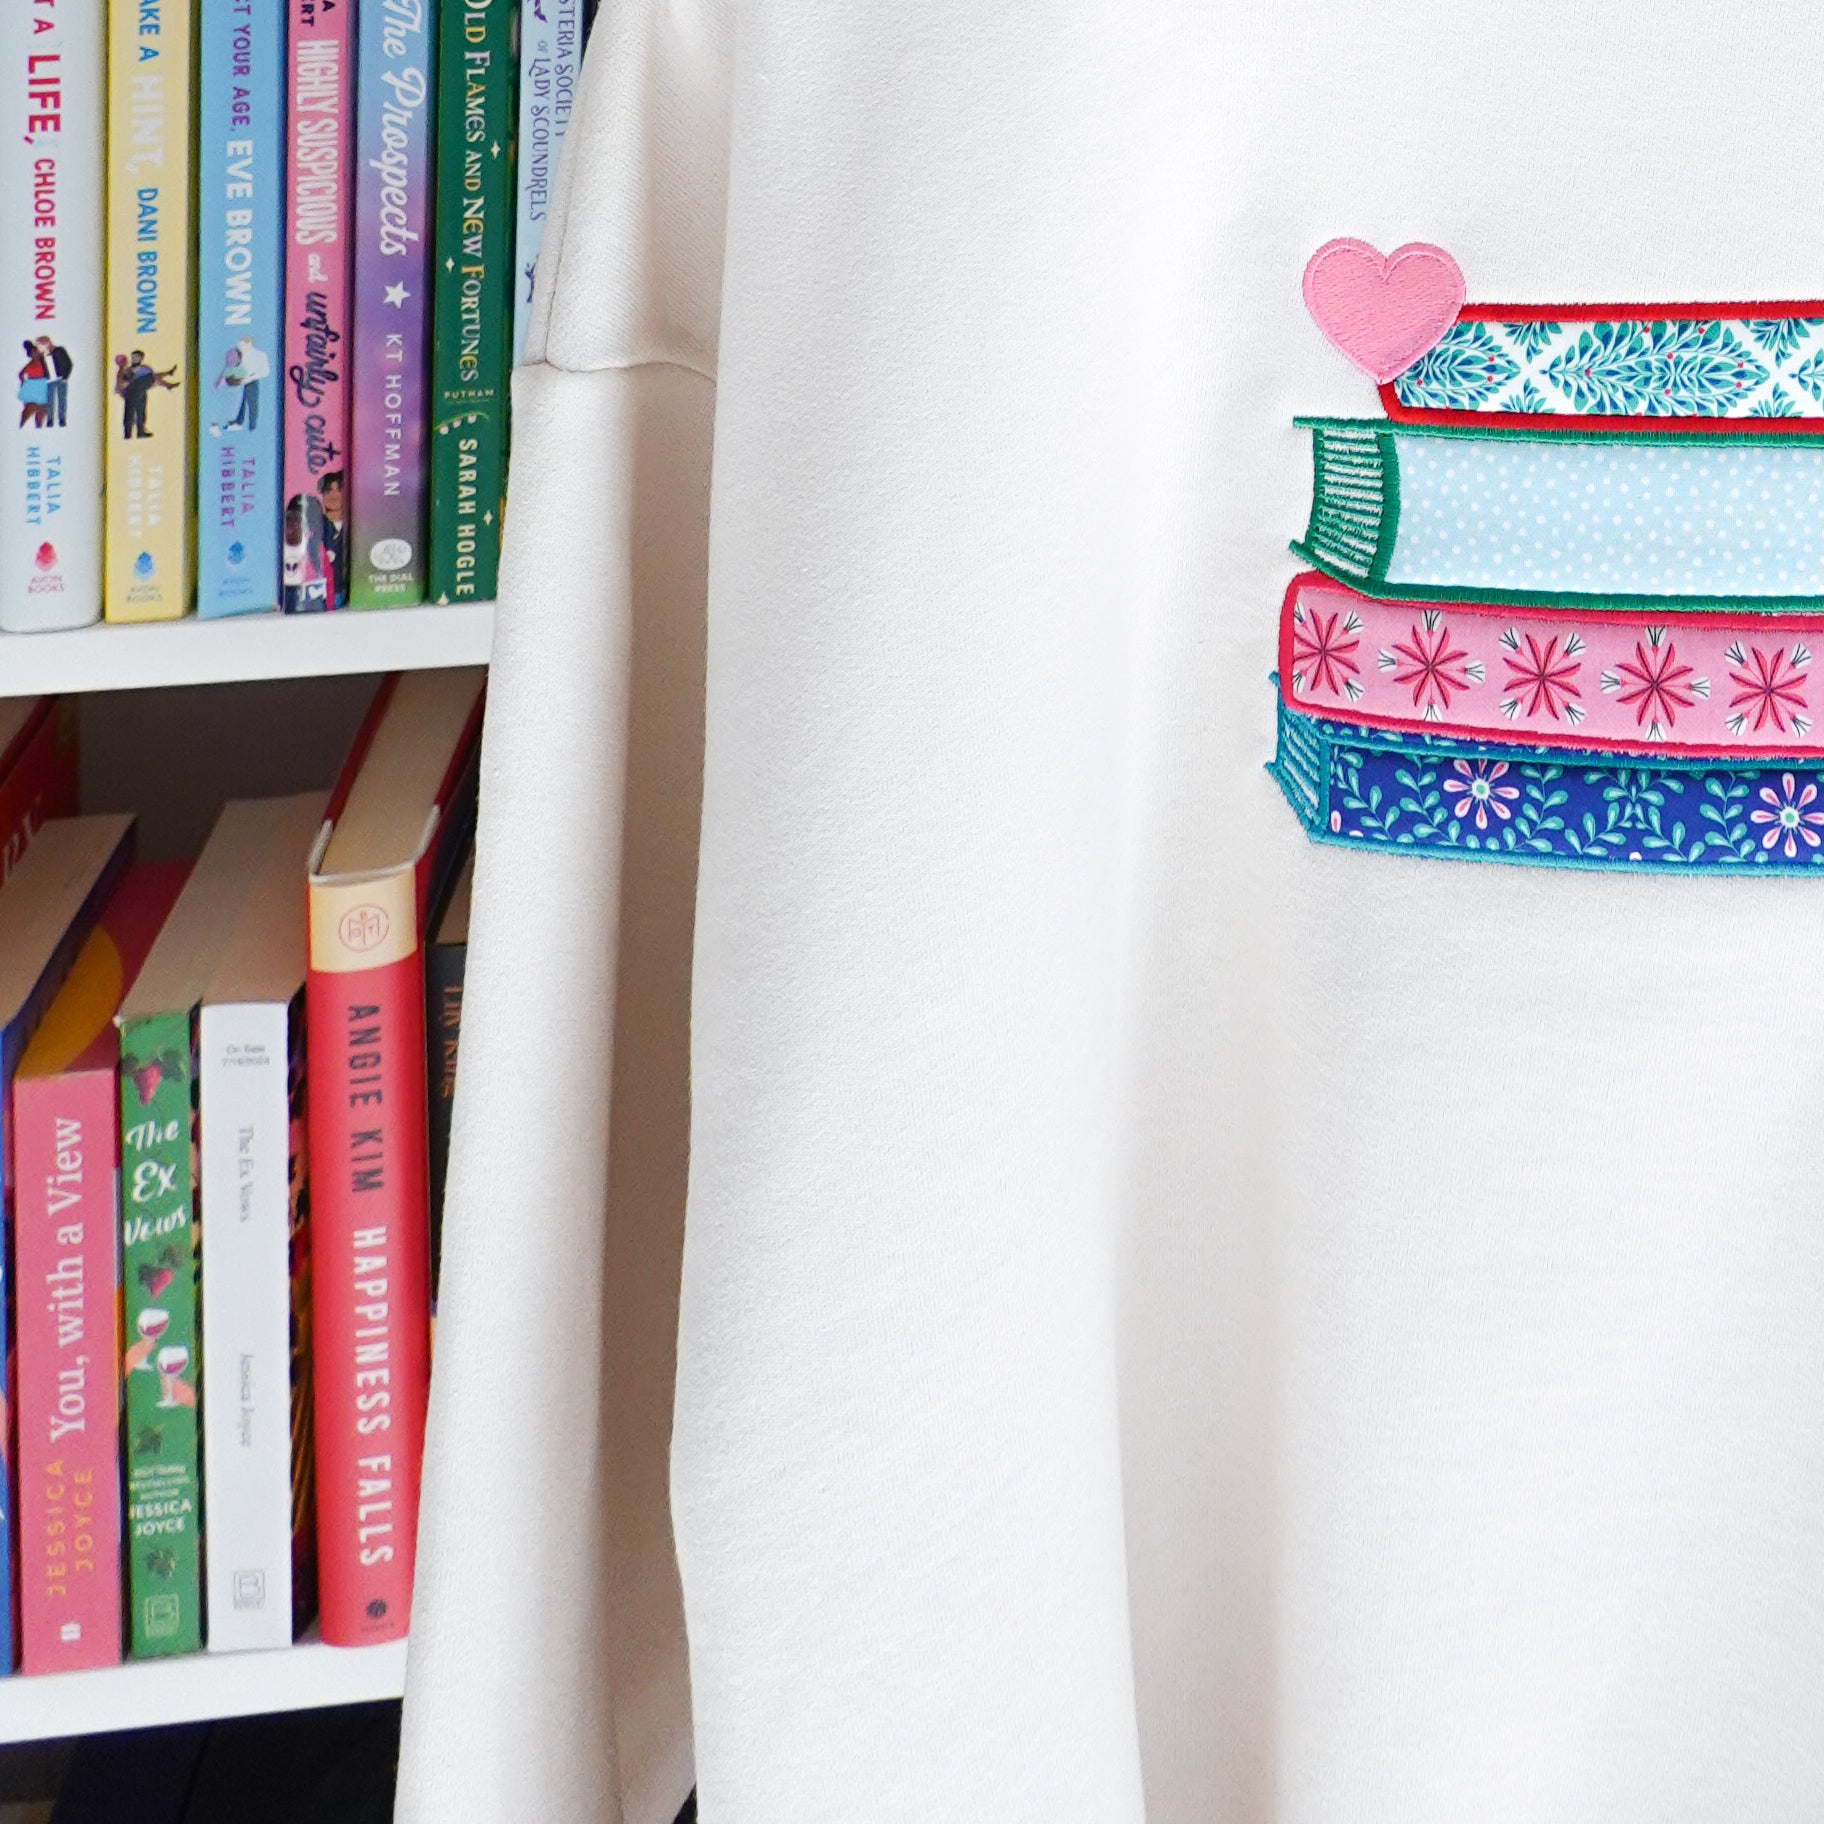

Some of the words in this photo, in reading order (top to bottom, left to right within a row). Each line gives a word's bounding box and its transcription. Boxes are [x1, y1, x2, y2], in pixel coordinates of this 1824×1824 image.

[34, 18, 51, 35] A
[232, 21, 253, 77] YOUR
[23, 53, 62, 149] LIFE,
[34, 158, 55, 230] CHLOE
[226, 139, 255, 196] EVE
[378, 68, 427, 257] Prospects
[465, 149, 483, 194] AND
[34, 236, 55, 320] BROWN
[225, 206, 255, 327] BROWN
[383, 334, 401, 364] KT
[383, 374, 401, 497] HOFFMAN
[345, 1004, 380, 1109] ANGIE
[47, 1117, 85, 1212] View
[351, 1125, 384, 1195] KIM
[58, 1219, 83, 1240] a
[47, 1246, 85, 1347] with
[352, 1228, 390, 1435] HAPPINESS
[48, 1354, 89, 1443] You,
[74, 1468, 93, 1572] JOYCE
[356, 1443, 393, 1570] FALLS
